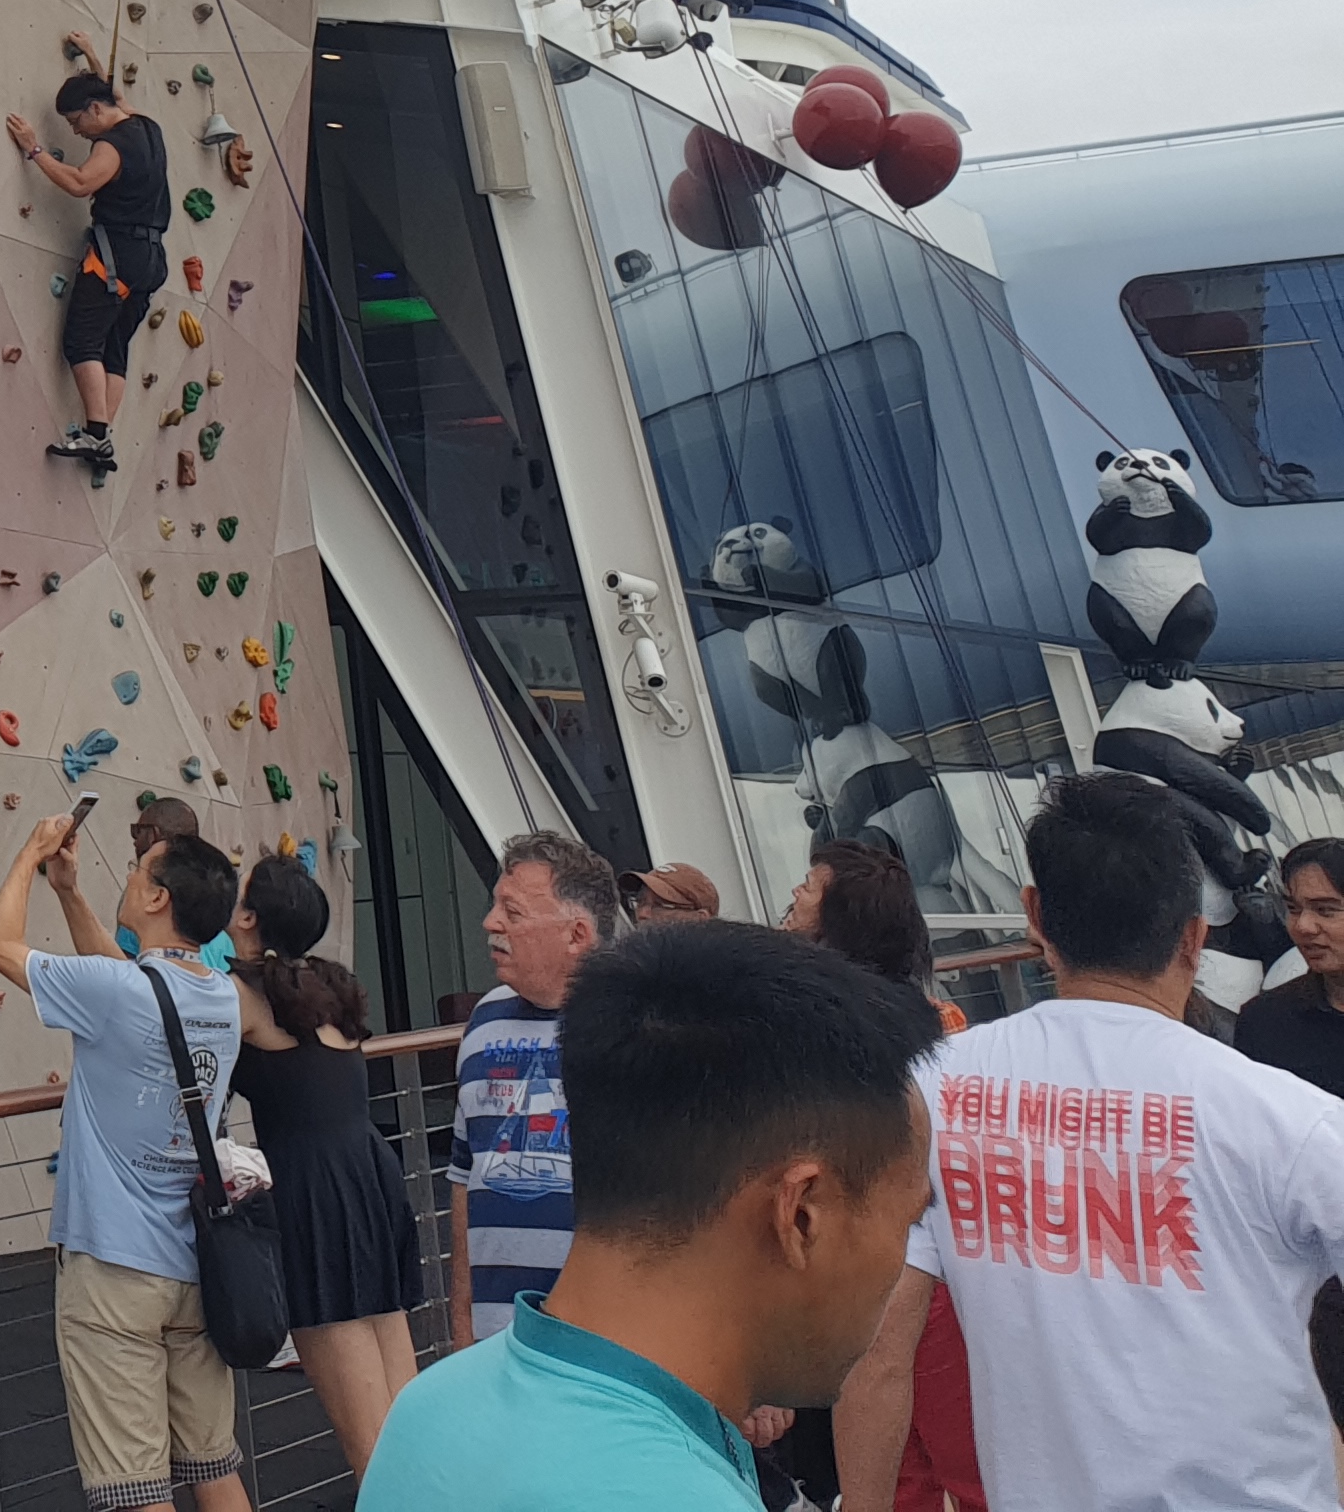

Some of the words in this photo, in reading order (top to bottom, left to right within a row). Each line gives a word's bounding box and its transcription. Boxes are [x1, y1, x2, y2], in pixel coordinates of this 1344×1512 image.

[484, 1037, 542, 1057] BEACH
[192, 1051, 217, 1068] UTER
[194, 1066, 216, 1084] PACE
[488, 1084, 514, 1096] CLUB
[938, 1073, 1010, 1137] YOU
[1018, 1080, 1133, 1153] MIGHT
[1142, 1093, 1195, 1162] BE
[937, 1131, 1205, 1291] DRUNK
